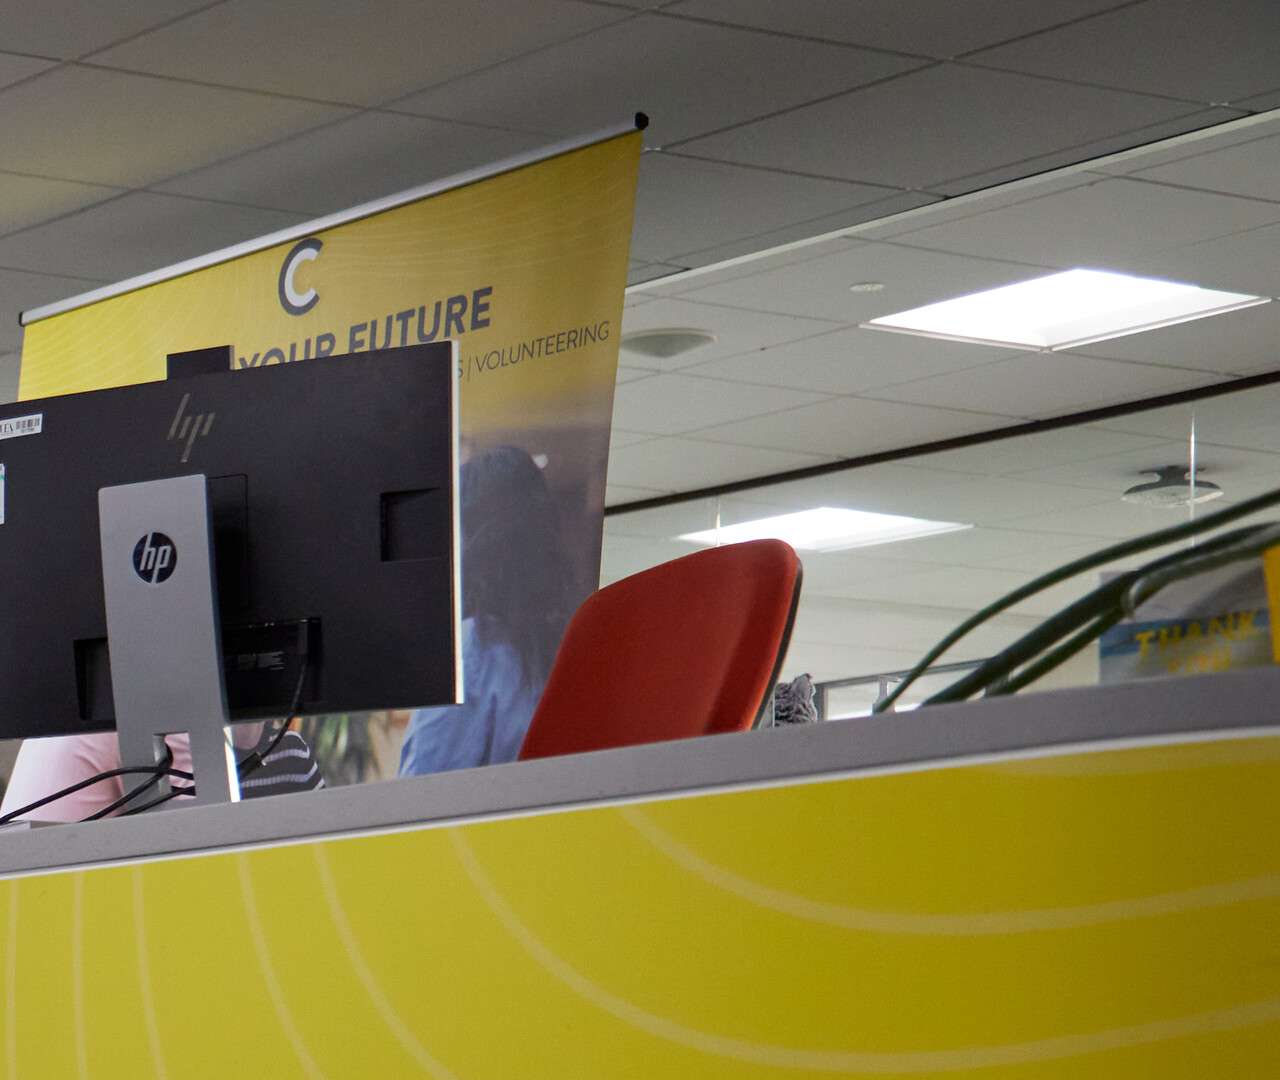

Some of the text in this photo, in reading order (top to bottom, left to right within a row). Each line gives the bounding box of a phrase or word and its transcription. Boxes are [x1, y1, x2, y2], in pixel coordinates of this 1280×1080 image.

[348, 285, 494, 354] FUTURE
[475, 320, 611, 373] VOLUNTEERING
[137, 532, 173, 584] hp
